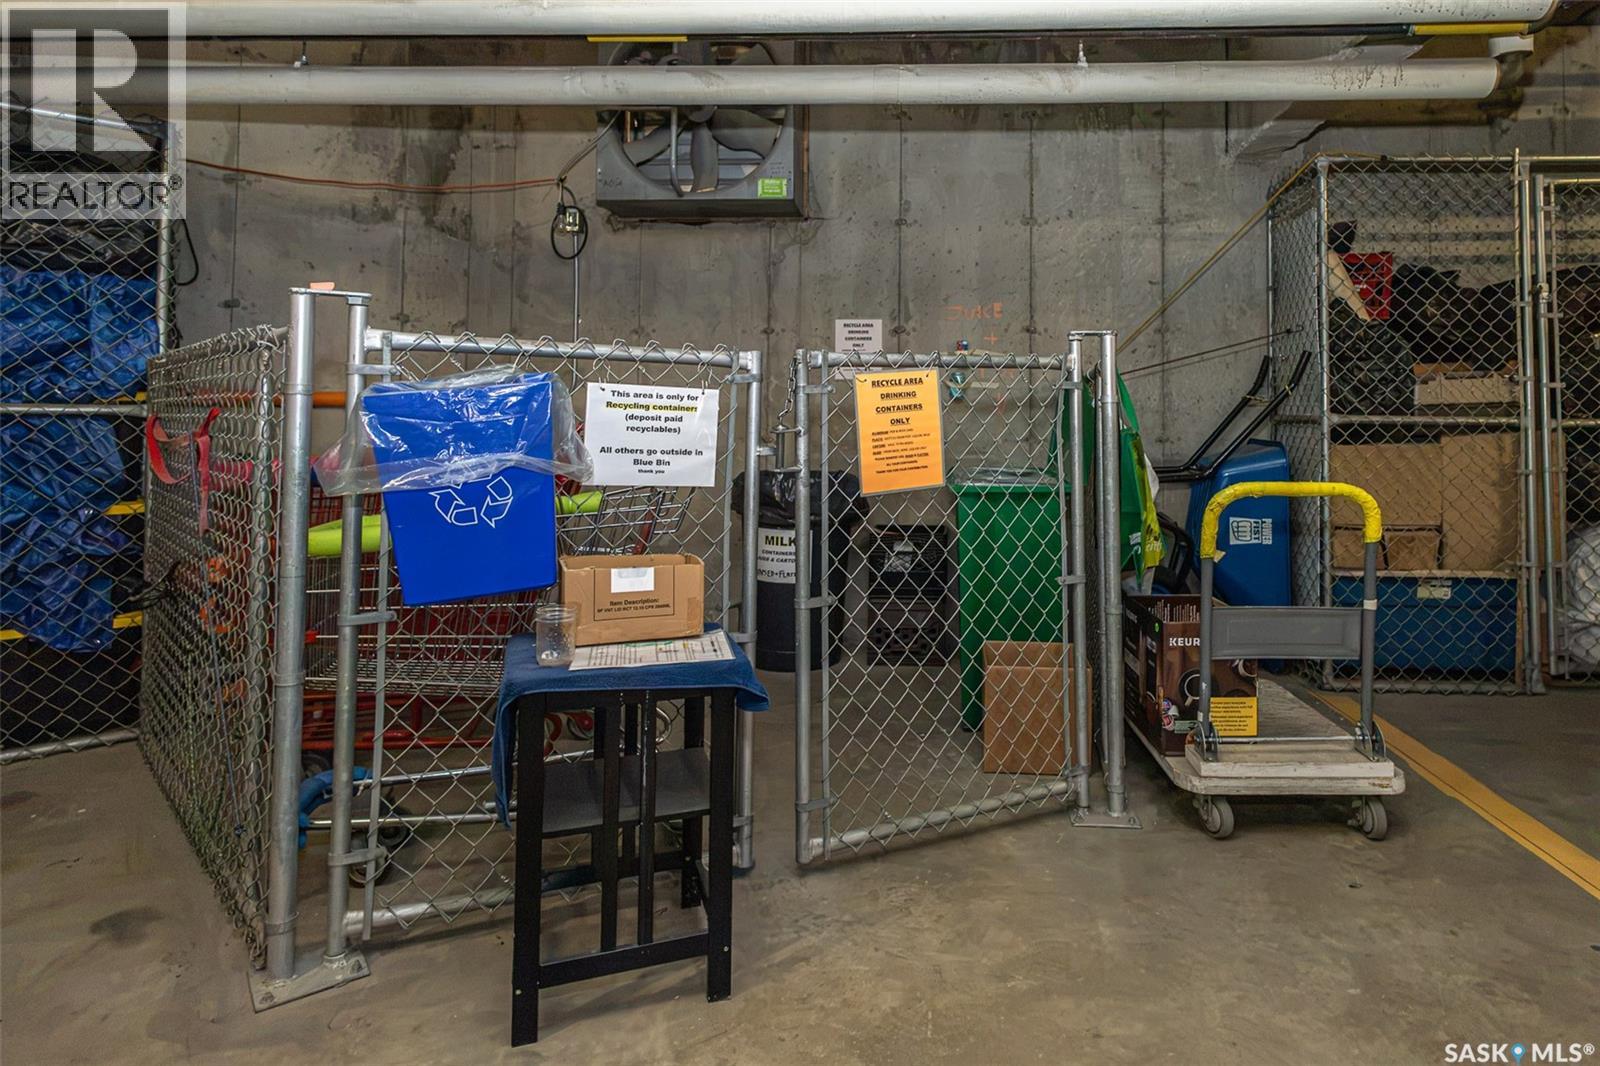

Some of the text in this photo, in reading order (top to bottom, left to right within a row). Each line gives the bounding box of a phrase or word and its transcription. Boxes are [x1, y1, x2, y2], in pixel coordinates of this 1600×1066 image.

[871, 377, 924, 388] RECYCLE AREA
[610, 390, 630, 398] This
[666, 393, 685, 402] only
[880, 390, 917, 400] DRINKING
[606, 401, 650, 412] Recycling
[875, 403, 923, 413] CONTAINERS
[625, 414, 683, 423] (deposit paid
[626, 425, 681, 434] recyclables)
[614, 446, 644, 455] others
[646, 449, 658, 457] go
[660, 448, 692, 456] outside
[764, 535, 796, 546] MILK
[758, 568, 774, 577] NSED
[1169, 637, 1200, 646] KEUR
